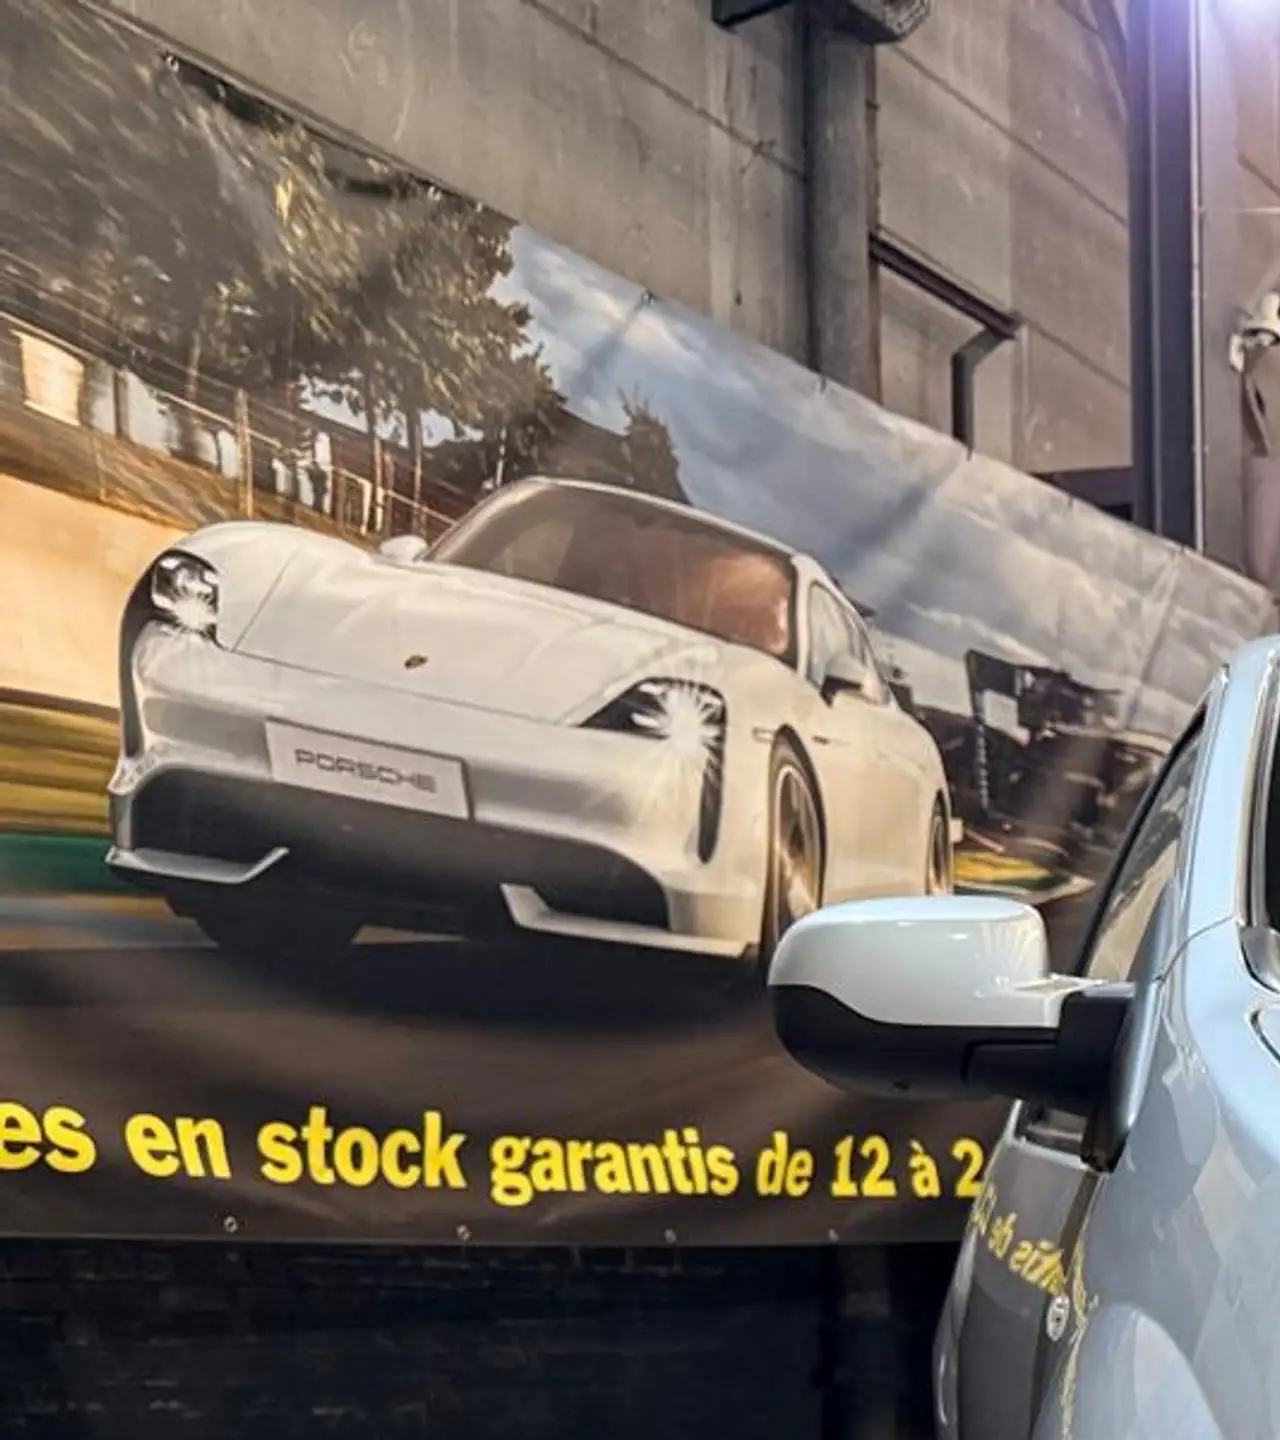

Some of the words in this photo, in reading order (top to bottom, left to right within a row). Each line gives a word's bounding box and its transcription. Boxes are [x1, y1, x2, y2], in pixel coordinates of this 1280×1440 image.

[295, 748, 437, 793] PORSCHE
[0, 1102, 97, 1173] es
[125, 1113, 231, 1179] en
[257, 1106, 467, 1188] stock
[490, 1128, 740, 1206] garantis
[757, 1131, 814, 1197] de
[831, 1134, 897, 1198] 12
[909, 1140, 941, 1198] à
